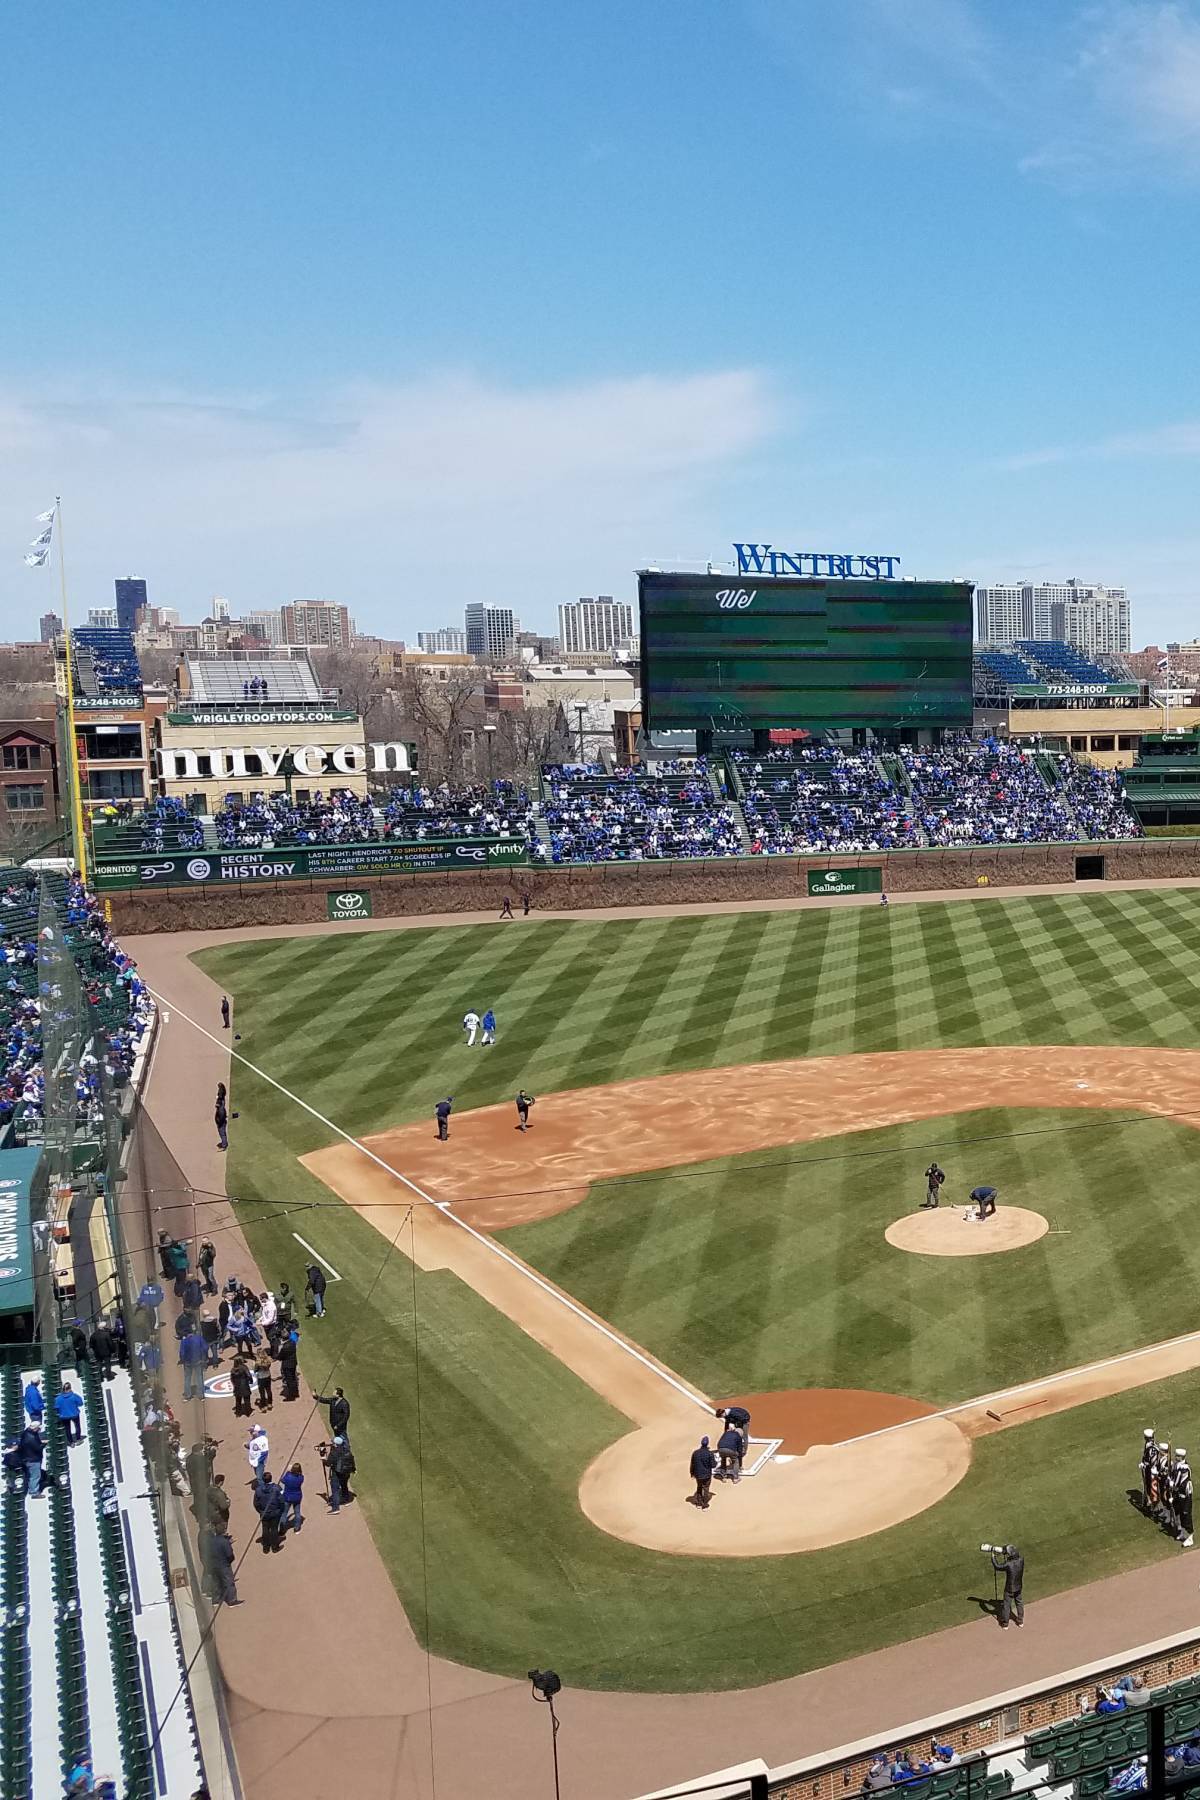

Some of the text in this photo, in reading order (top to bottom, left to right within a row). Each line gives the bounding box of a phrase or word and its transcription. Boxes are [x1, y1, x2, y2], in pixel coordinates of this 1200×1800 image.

[732, 544, 900, 580] WINTRUST
[1047, 686, 1108, 694] 773-248-ROOF
[192, 712, 333, 724] WRIGLEYROOFTOPS.COM
[156, 742, 412, 778] nuveen
[488, 843, 524, 856] xfinity
[221, 854, 264, 864] RECENT
[222, 863, 296, 878] HISTORY
[812, 883, 856, 893] Gallagher
[332, 910, 368, 918] TOYOTA
